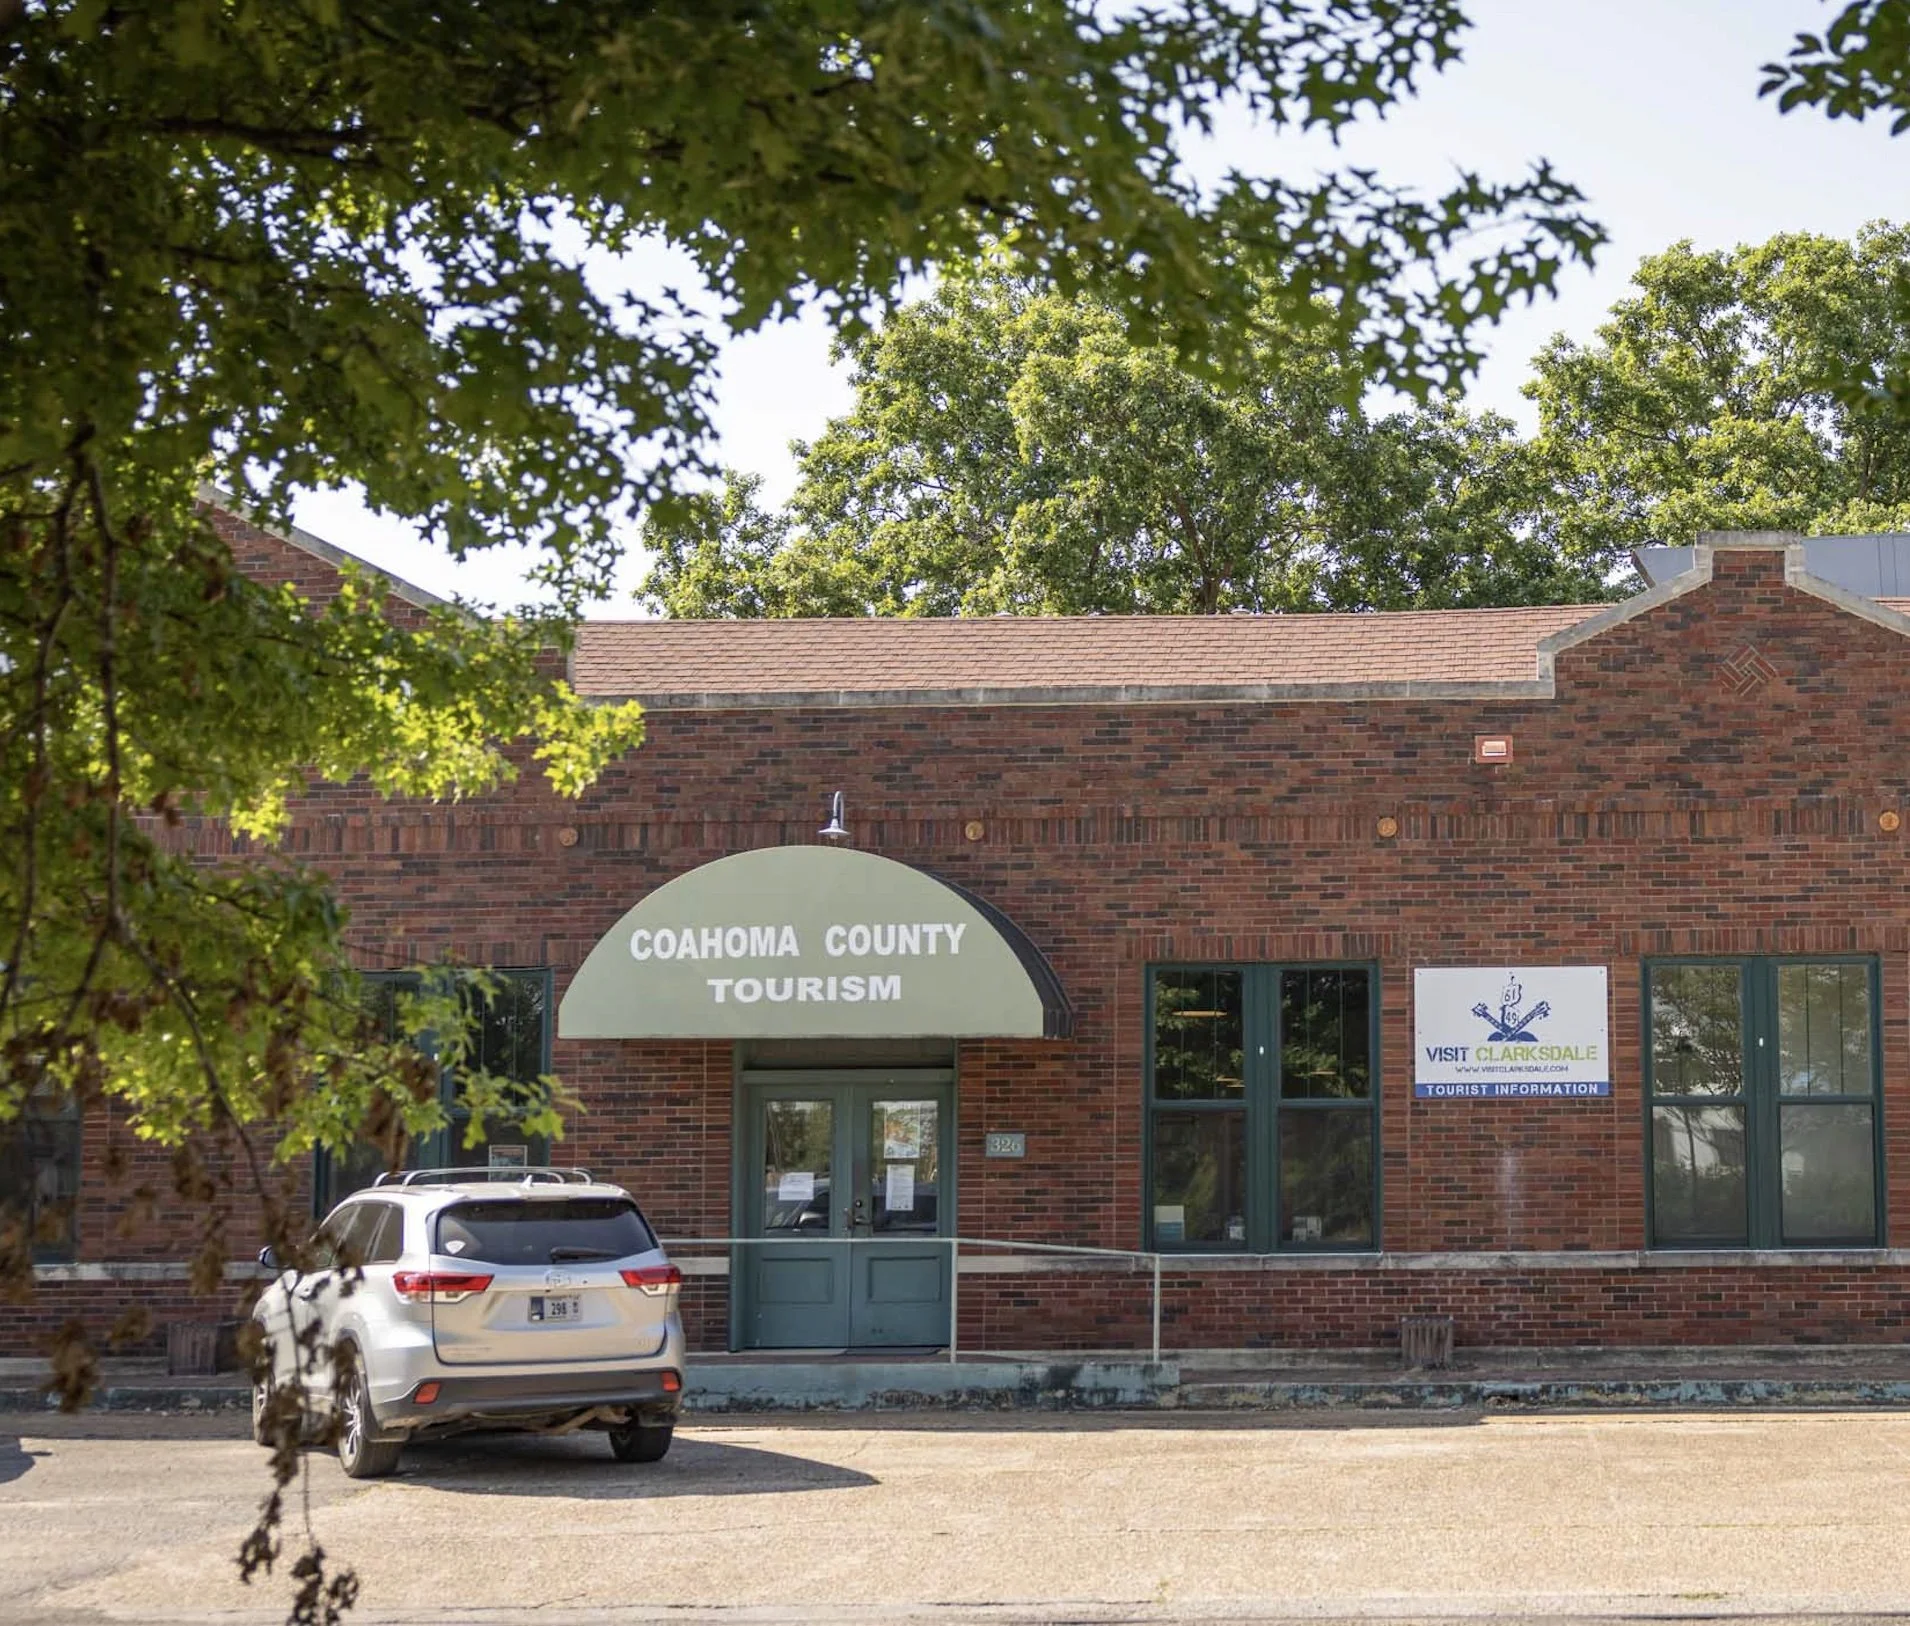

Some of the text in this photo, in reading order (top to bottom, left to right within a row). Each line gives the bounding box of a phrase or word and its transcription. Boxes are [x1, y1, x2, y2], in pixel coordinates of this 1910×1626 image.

[630, 923, 966, 960] COAHOMA COUNTY
[708, 975, 902, 1003] TOURISM
[1504, 988, 1515, 1002] 61
[1505, 1011, 1517, 1025] 49
[1426, 1046, 1598, 1062] VISIT CLARKSDALE
[1427, 1083, 1598, 1096] TOURIST INFORMATION
